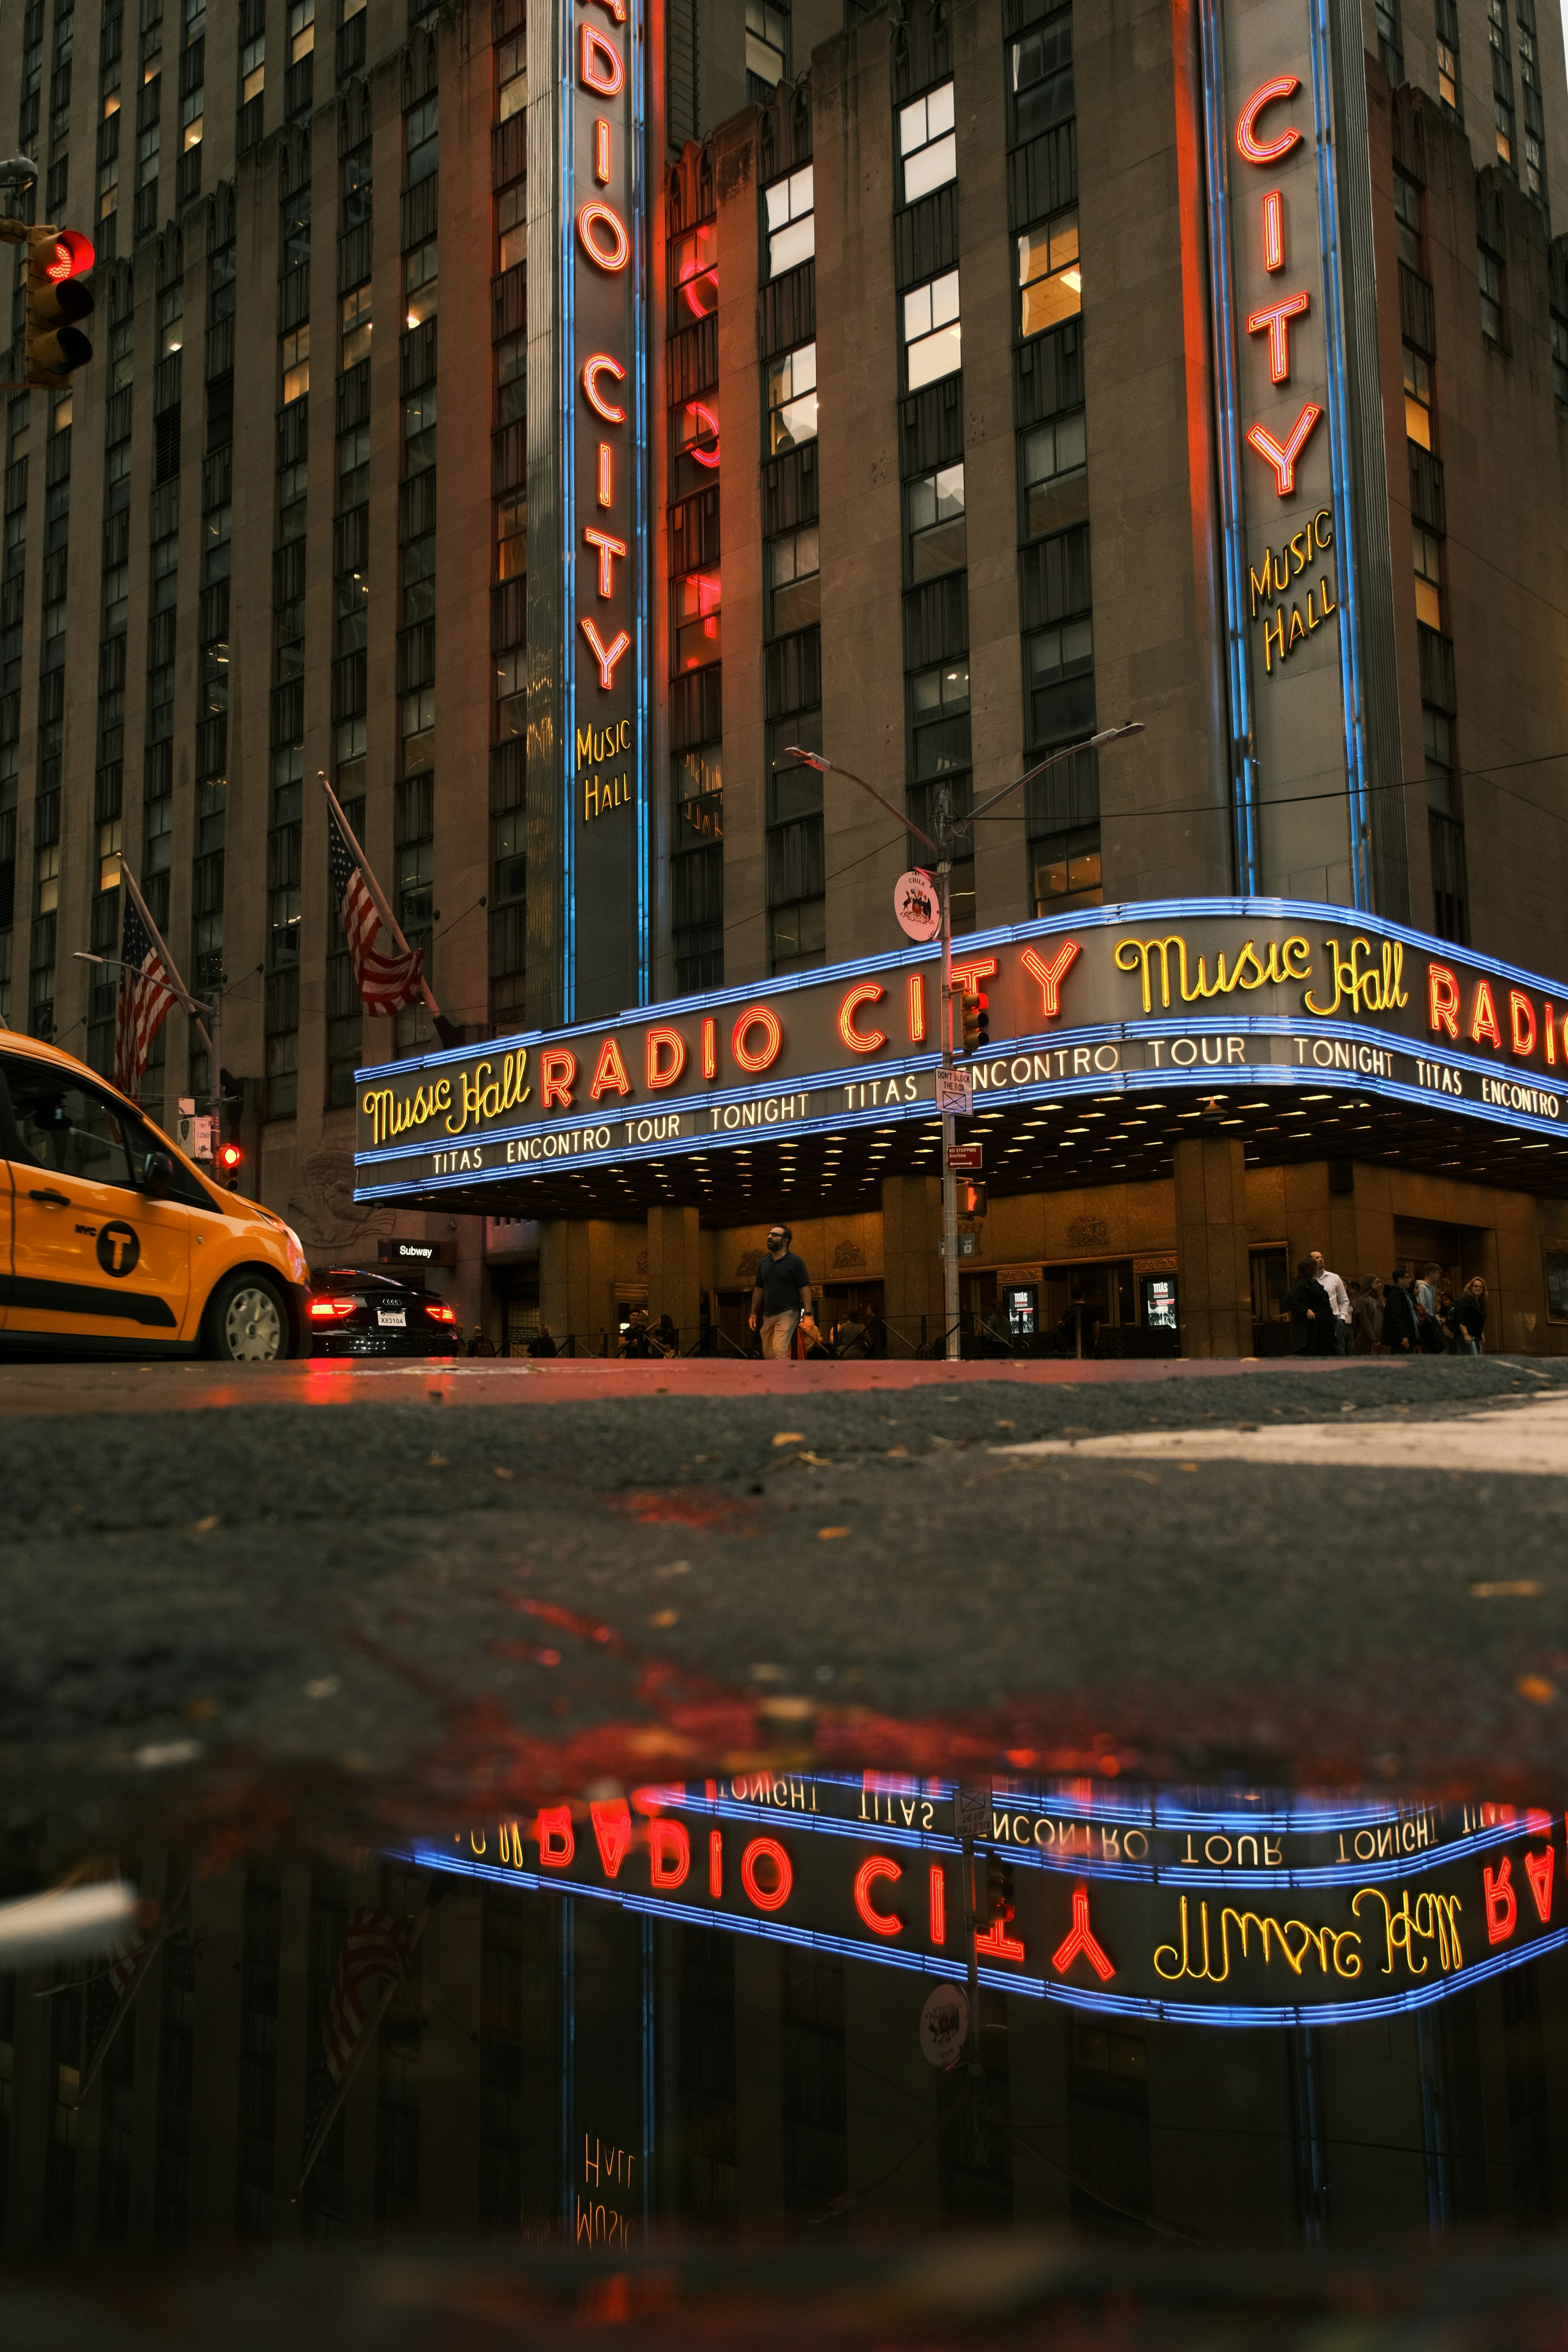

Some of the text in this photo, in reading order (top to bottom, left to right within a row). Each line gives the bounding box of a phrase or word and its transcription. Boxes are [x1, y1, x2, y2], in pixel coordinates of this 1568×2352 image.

[578, 0, 630, 271] DIO
[1236, 76, 1321, 496] CITY
[581, 353, 631, 690] CITY
[909, 877, 925, 887] CHILE
[363, 934, 1568, 1144] Music Hall RADIO CITY Music Hall RADI
[433, 1037, 1559, 1174] TITAS ENCONTRO TOUR TONIGHT TITAS NCONTRO TOUR TONIGHT TITAS ENCONTRO
[937, 1071, 970, 1083] DON'T BLOCK
[943, 1081, 965, 1092] THE BOX
[400, 1245, 433, 1259] Subway
